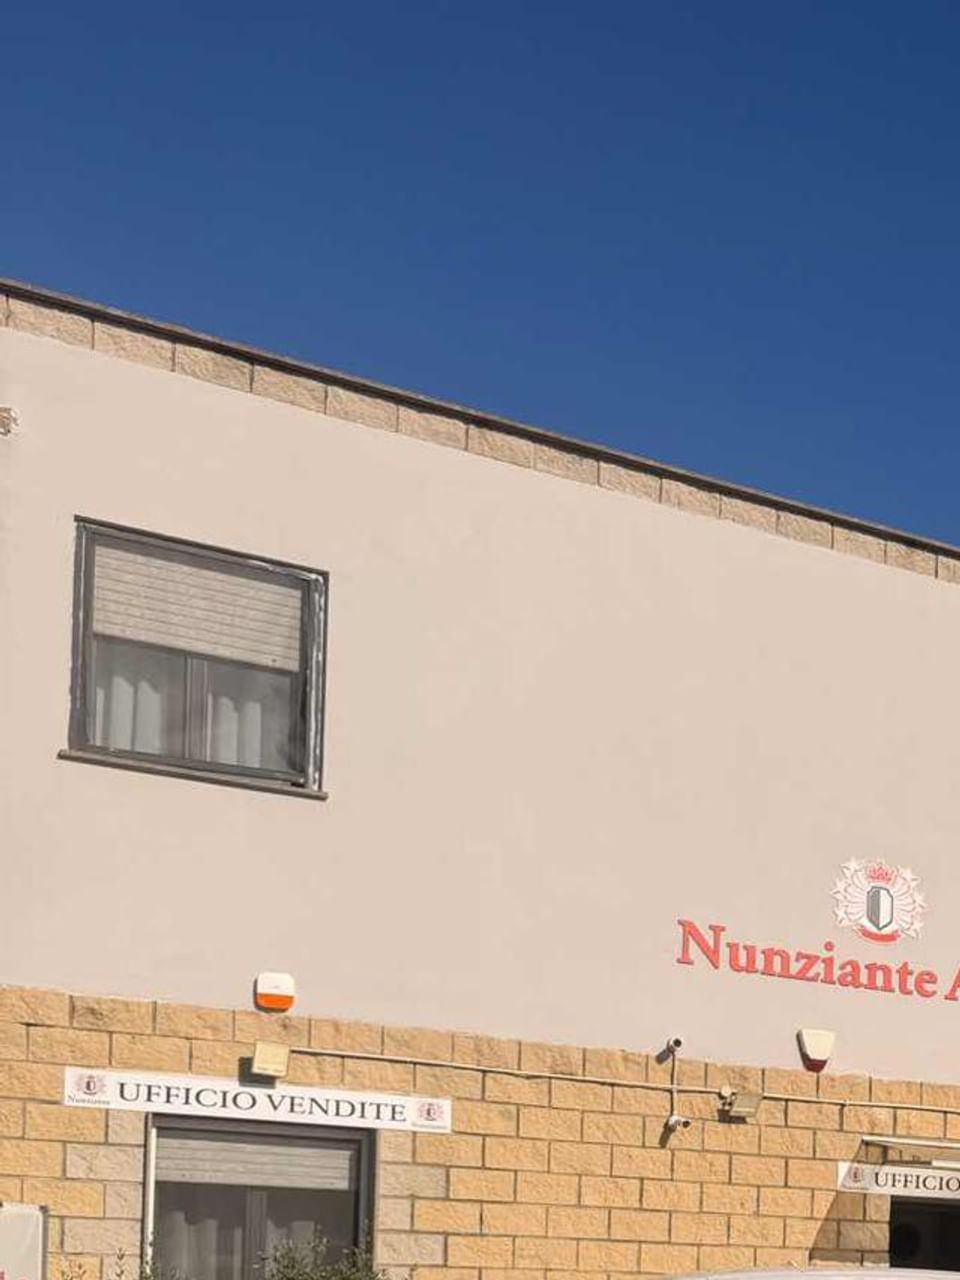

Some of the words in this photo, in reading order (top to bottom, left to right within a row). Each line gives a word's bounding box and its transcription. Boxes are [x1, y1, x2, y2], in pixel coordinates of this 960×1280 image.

[676, 919, 938, 998] Nunziante
[117, 1081, 257, 1111] UFFICIO
[266, 1093, 407, 1123] VENDITE
